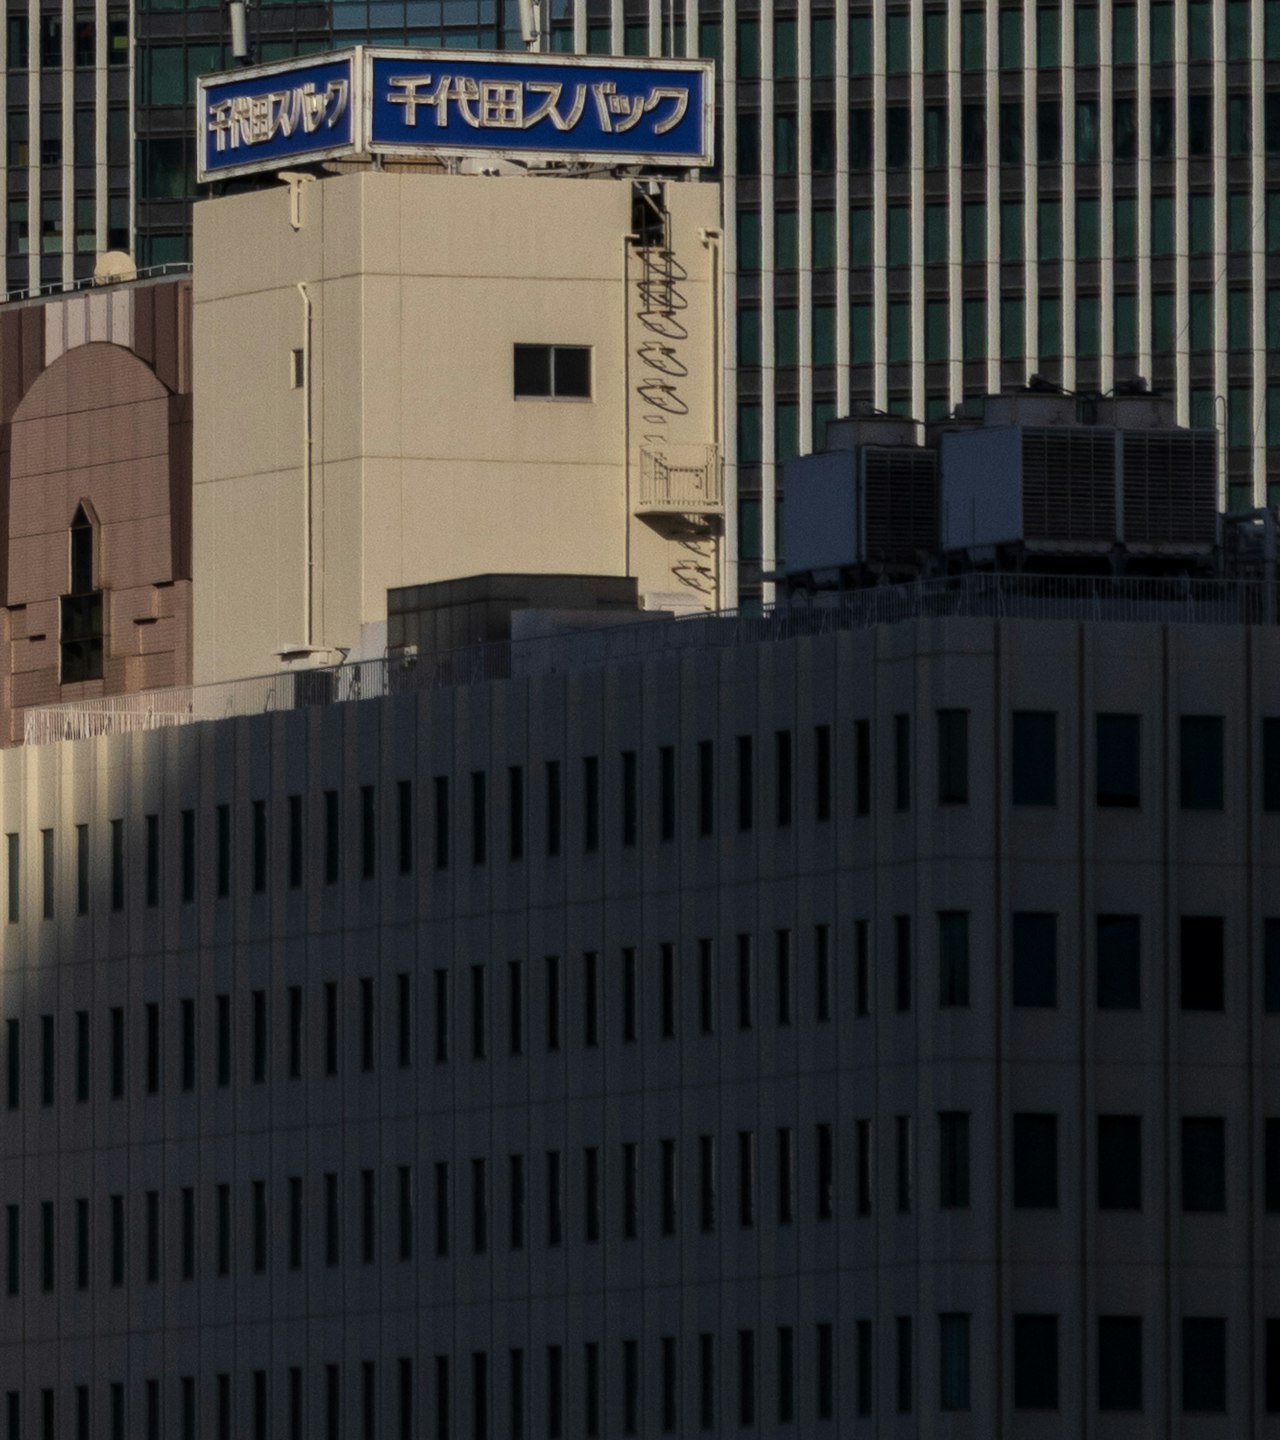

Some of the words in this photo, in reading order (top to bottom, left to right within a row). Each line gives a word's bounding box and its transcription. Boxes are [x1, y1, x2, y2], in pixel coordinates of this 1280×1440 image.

[386, 73, 689, 134] 千代田スバック
